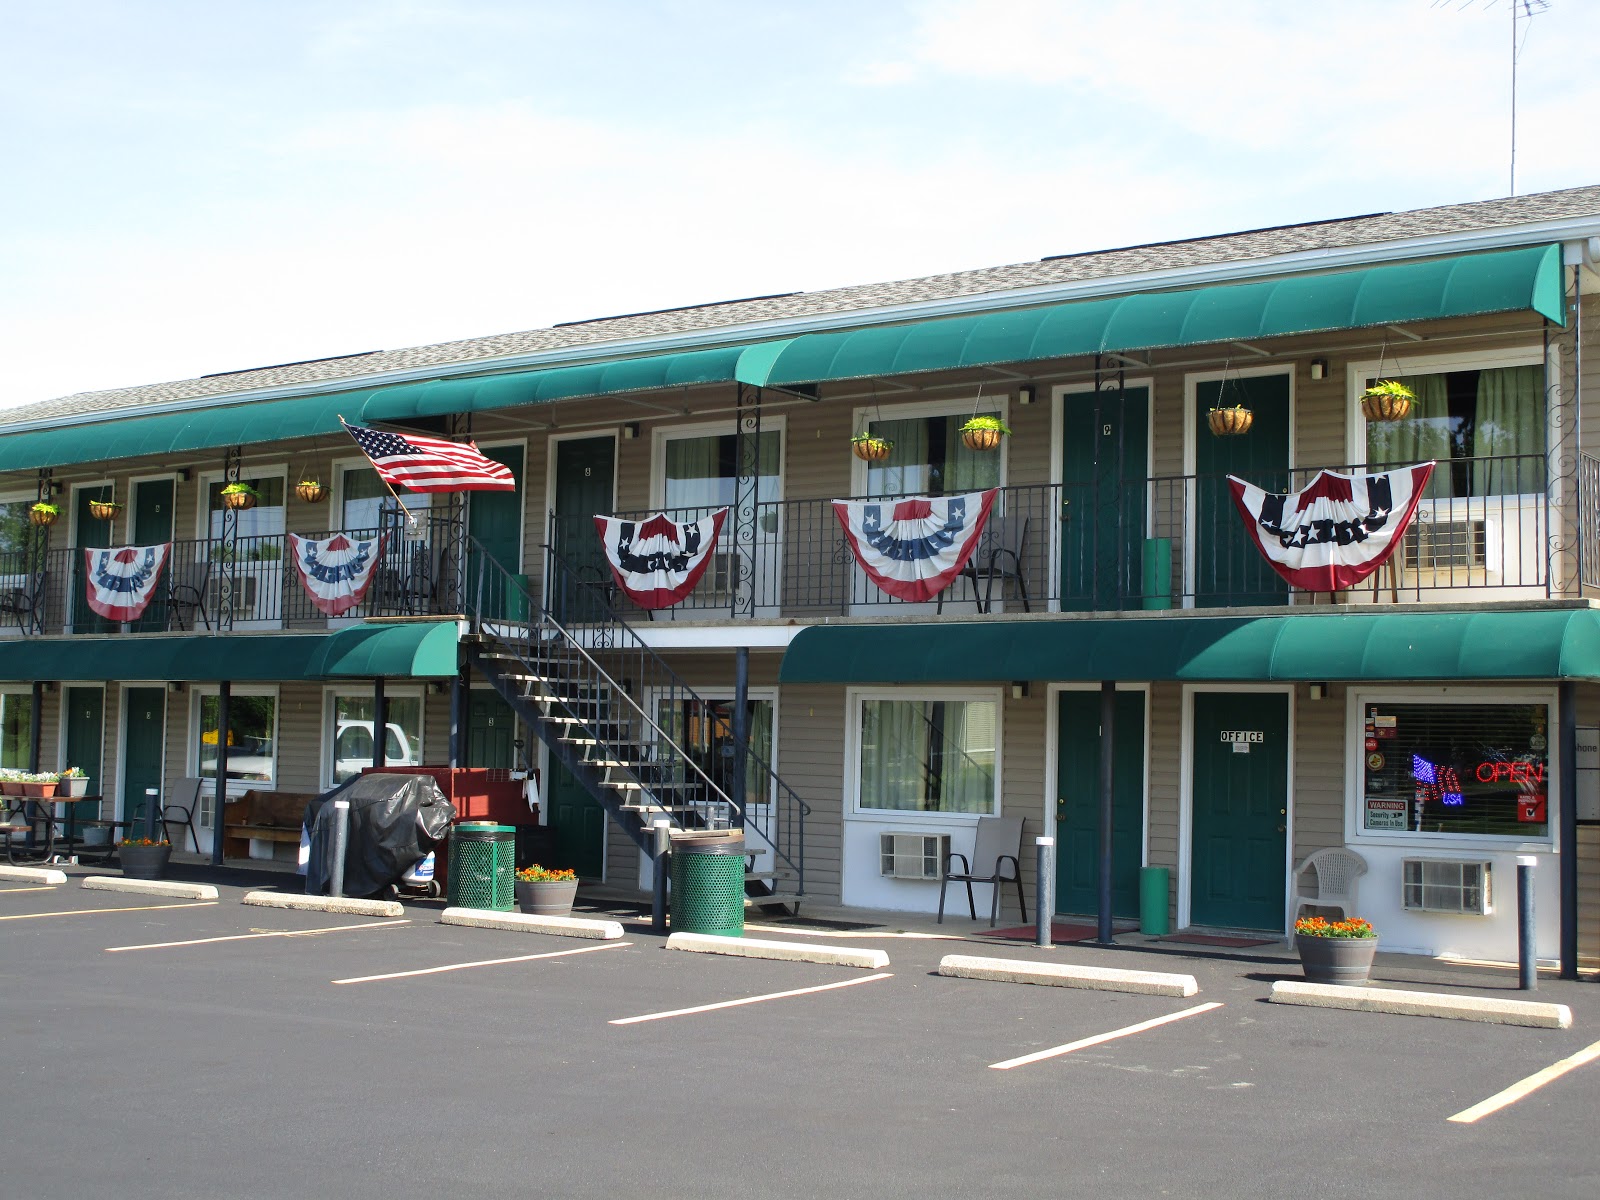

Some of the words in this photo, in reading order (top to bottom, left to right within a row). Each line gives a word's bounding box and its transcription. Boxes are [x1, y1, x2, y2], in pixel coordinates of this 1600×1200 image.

[1104, 425, 1110, 434] 9
[1221, 732, 1262, 741] OFFICE
[1575, 743, 1597, 752] hone
[1476, 762, 1543, 783] OPEN
[1442, 792, 1462, 805] USA
[1370, 811, 1389, 819] Security
